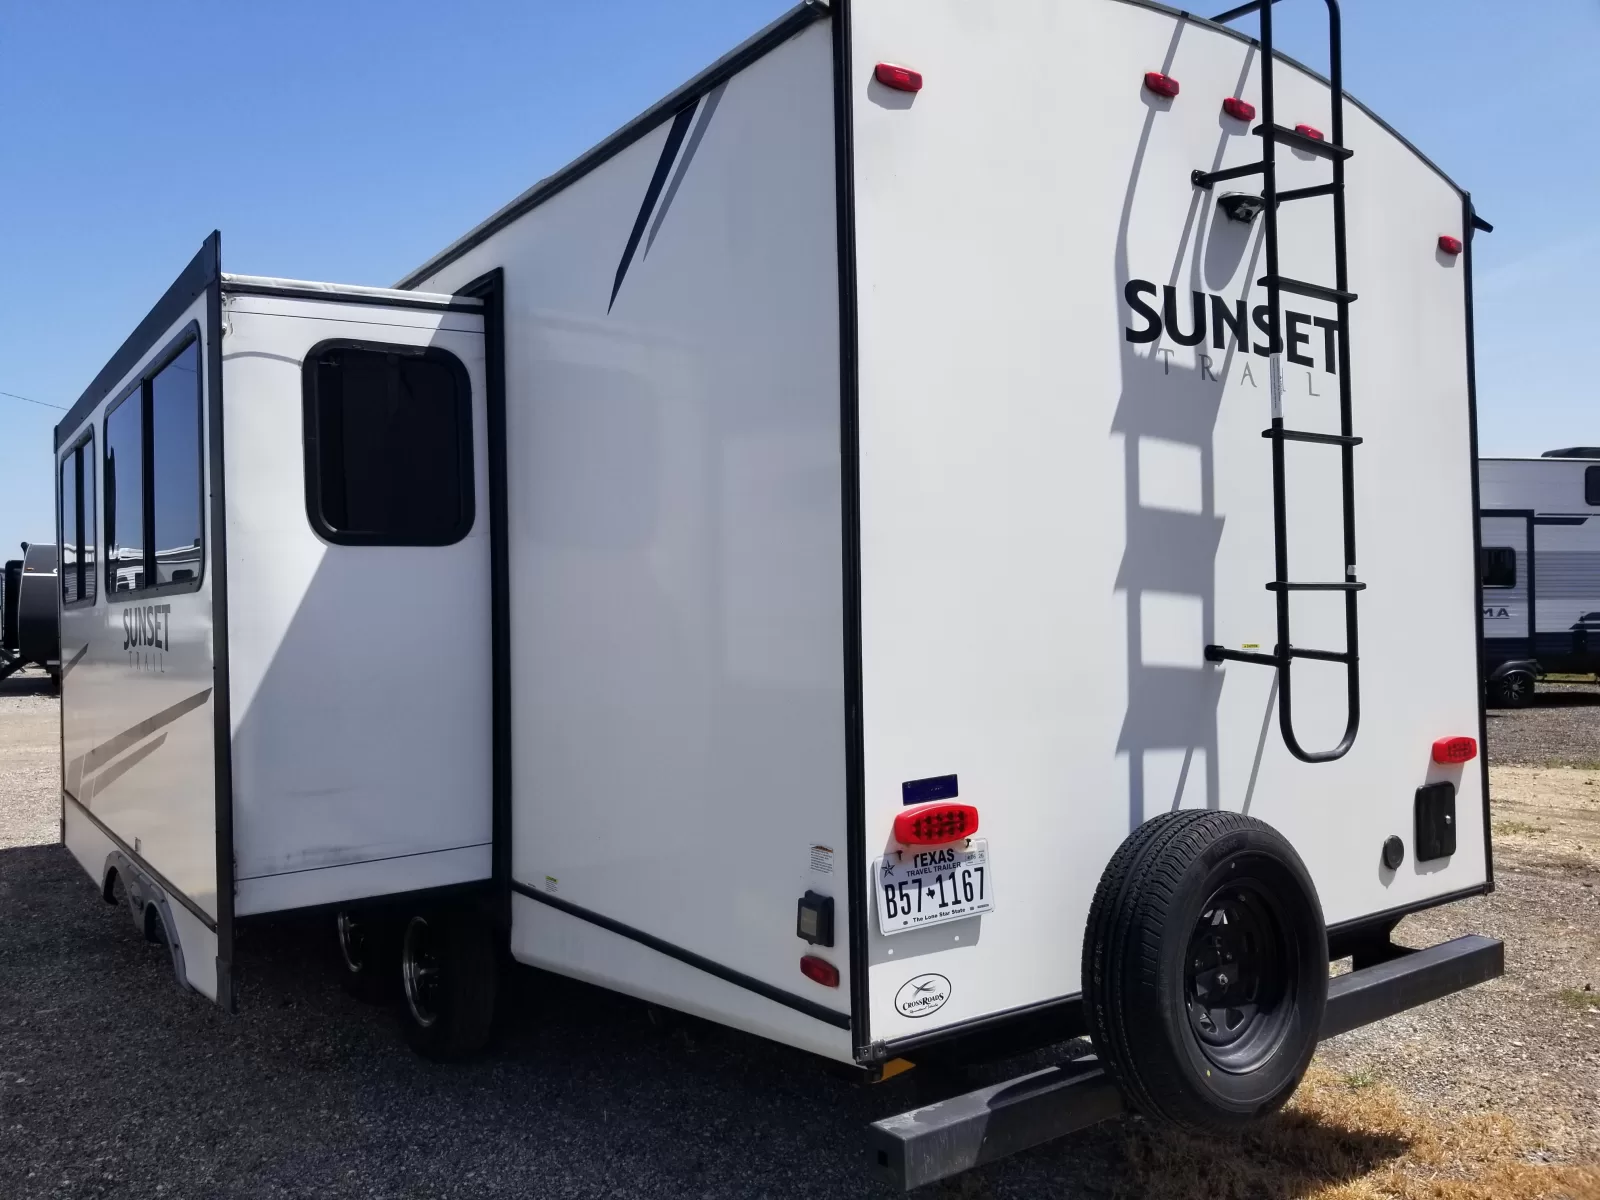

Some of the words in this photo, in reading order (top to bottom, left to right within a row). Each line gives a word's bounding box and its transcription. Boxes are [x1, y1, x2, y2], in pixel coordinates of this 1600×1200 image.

[1124, 279, 1339, 375] SUNSET
[1158, 348, 1321, 397] TRAL
[123, 604, 171, 652] SUNSET
[128, 651, 165, 673] TRAIL
[906, 866, 932, 877] TRAVEL
[933, 861, 961, 873] TRAILER
[913, 848, 955, 868] TEXAS
